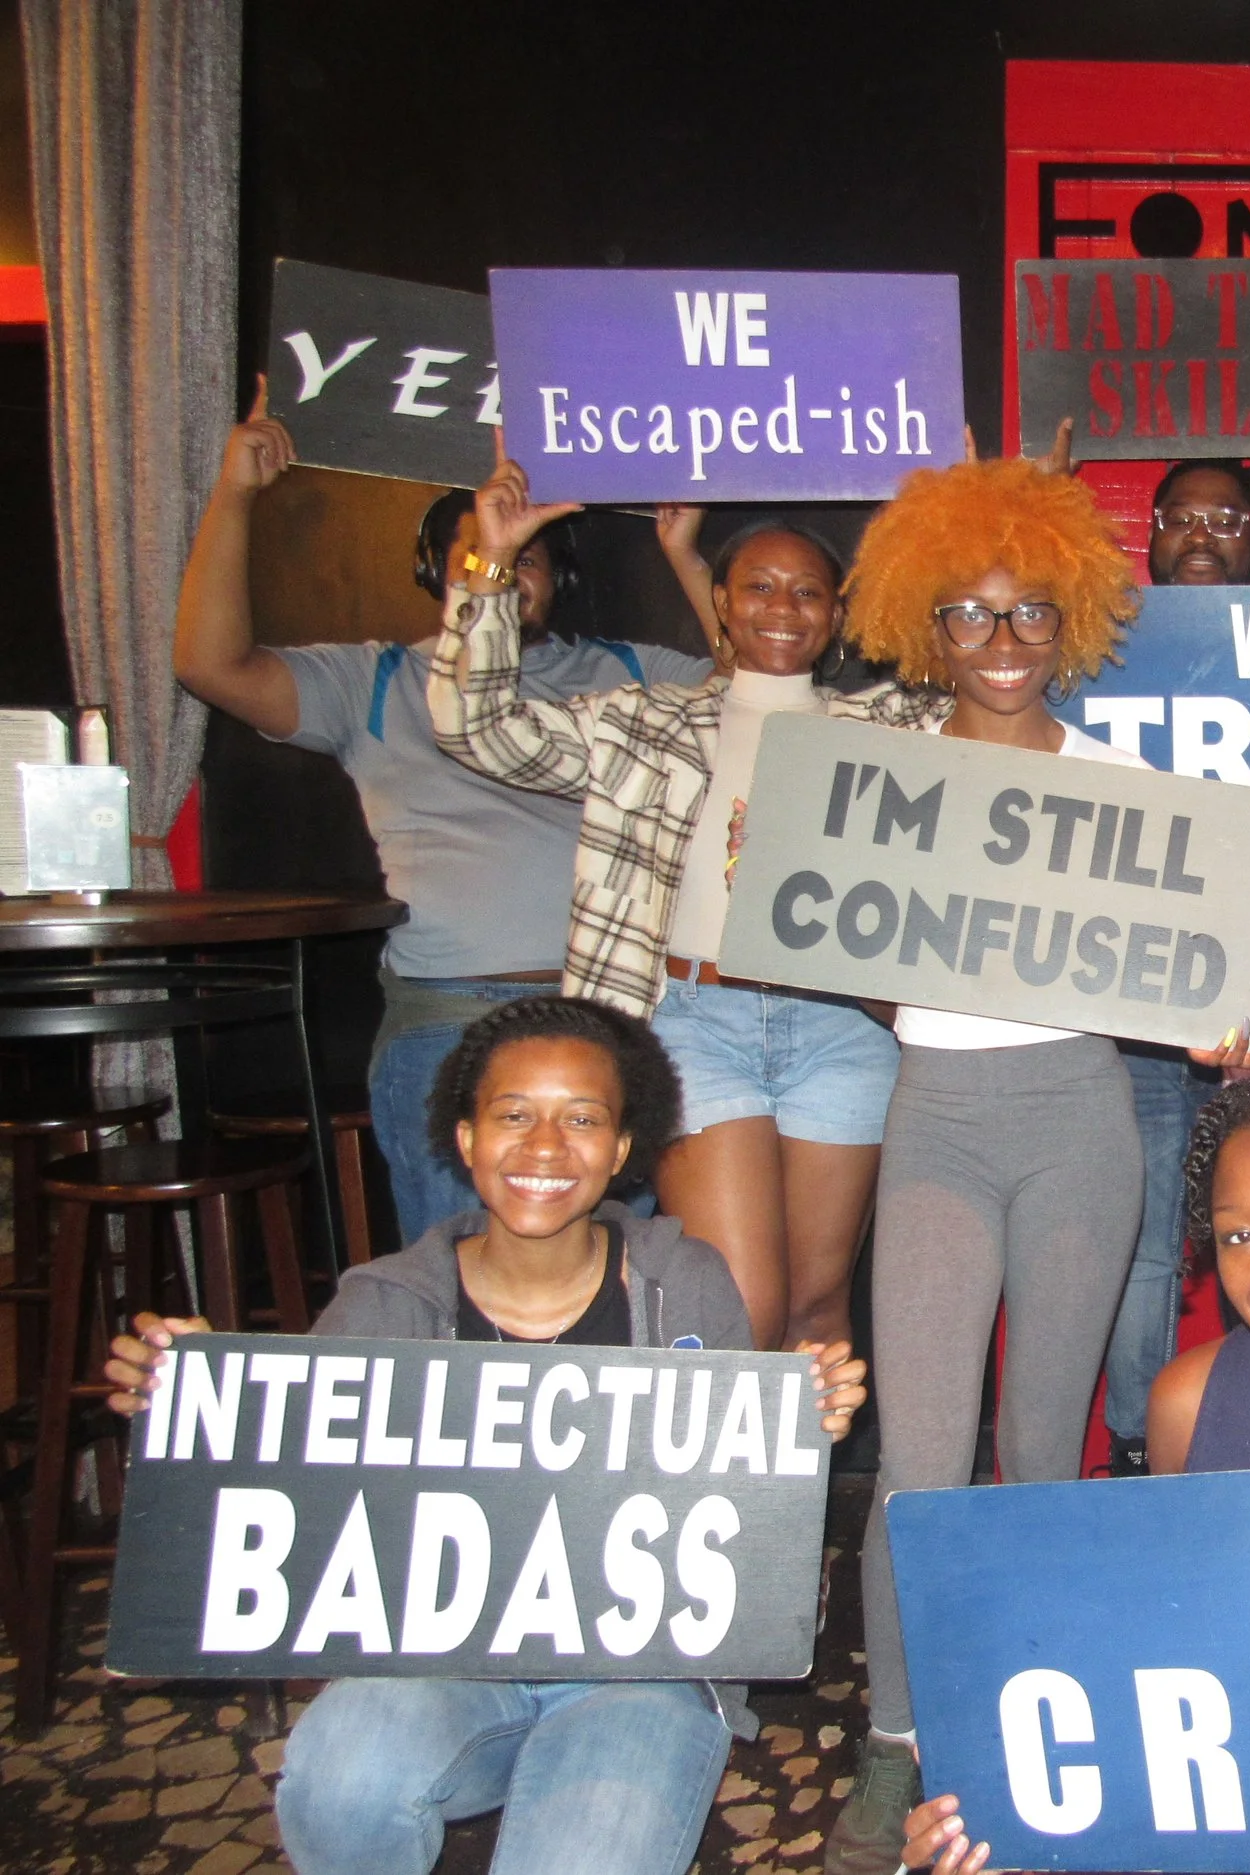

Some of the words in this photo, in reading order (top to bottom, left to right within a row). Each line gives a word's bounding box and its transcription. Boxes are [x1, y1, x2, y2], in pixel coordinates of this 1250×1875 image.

[675, 290, 770, 367] WE
[1021, 273, 1177, 351] MAD
[539, 374, 932, 481] Escaped-ish
[823, 759, 949, 854] I'M
[981, 787, 1206, 896] STILL
[770, 869, 1228, 1011] CONFUSED
[142, 1349, 821, 1476] INTELLECTUAL
[200, 1487, 742, 1657] BADASS
